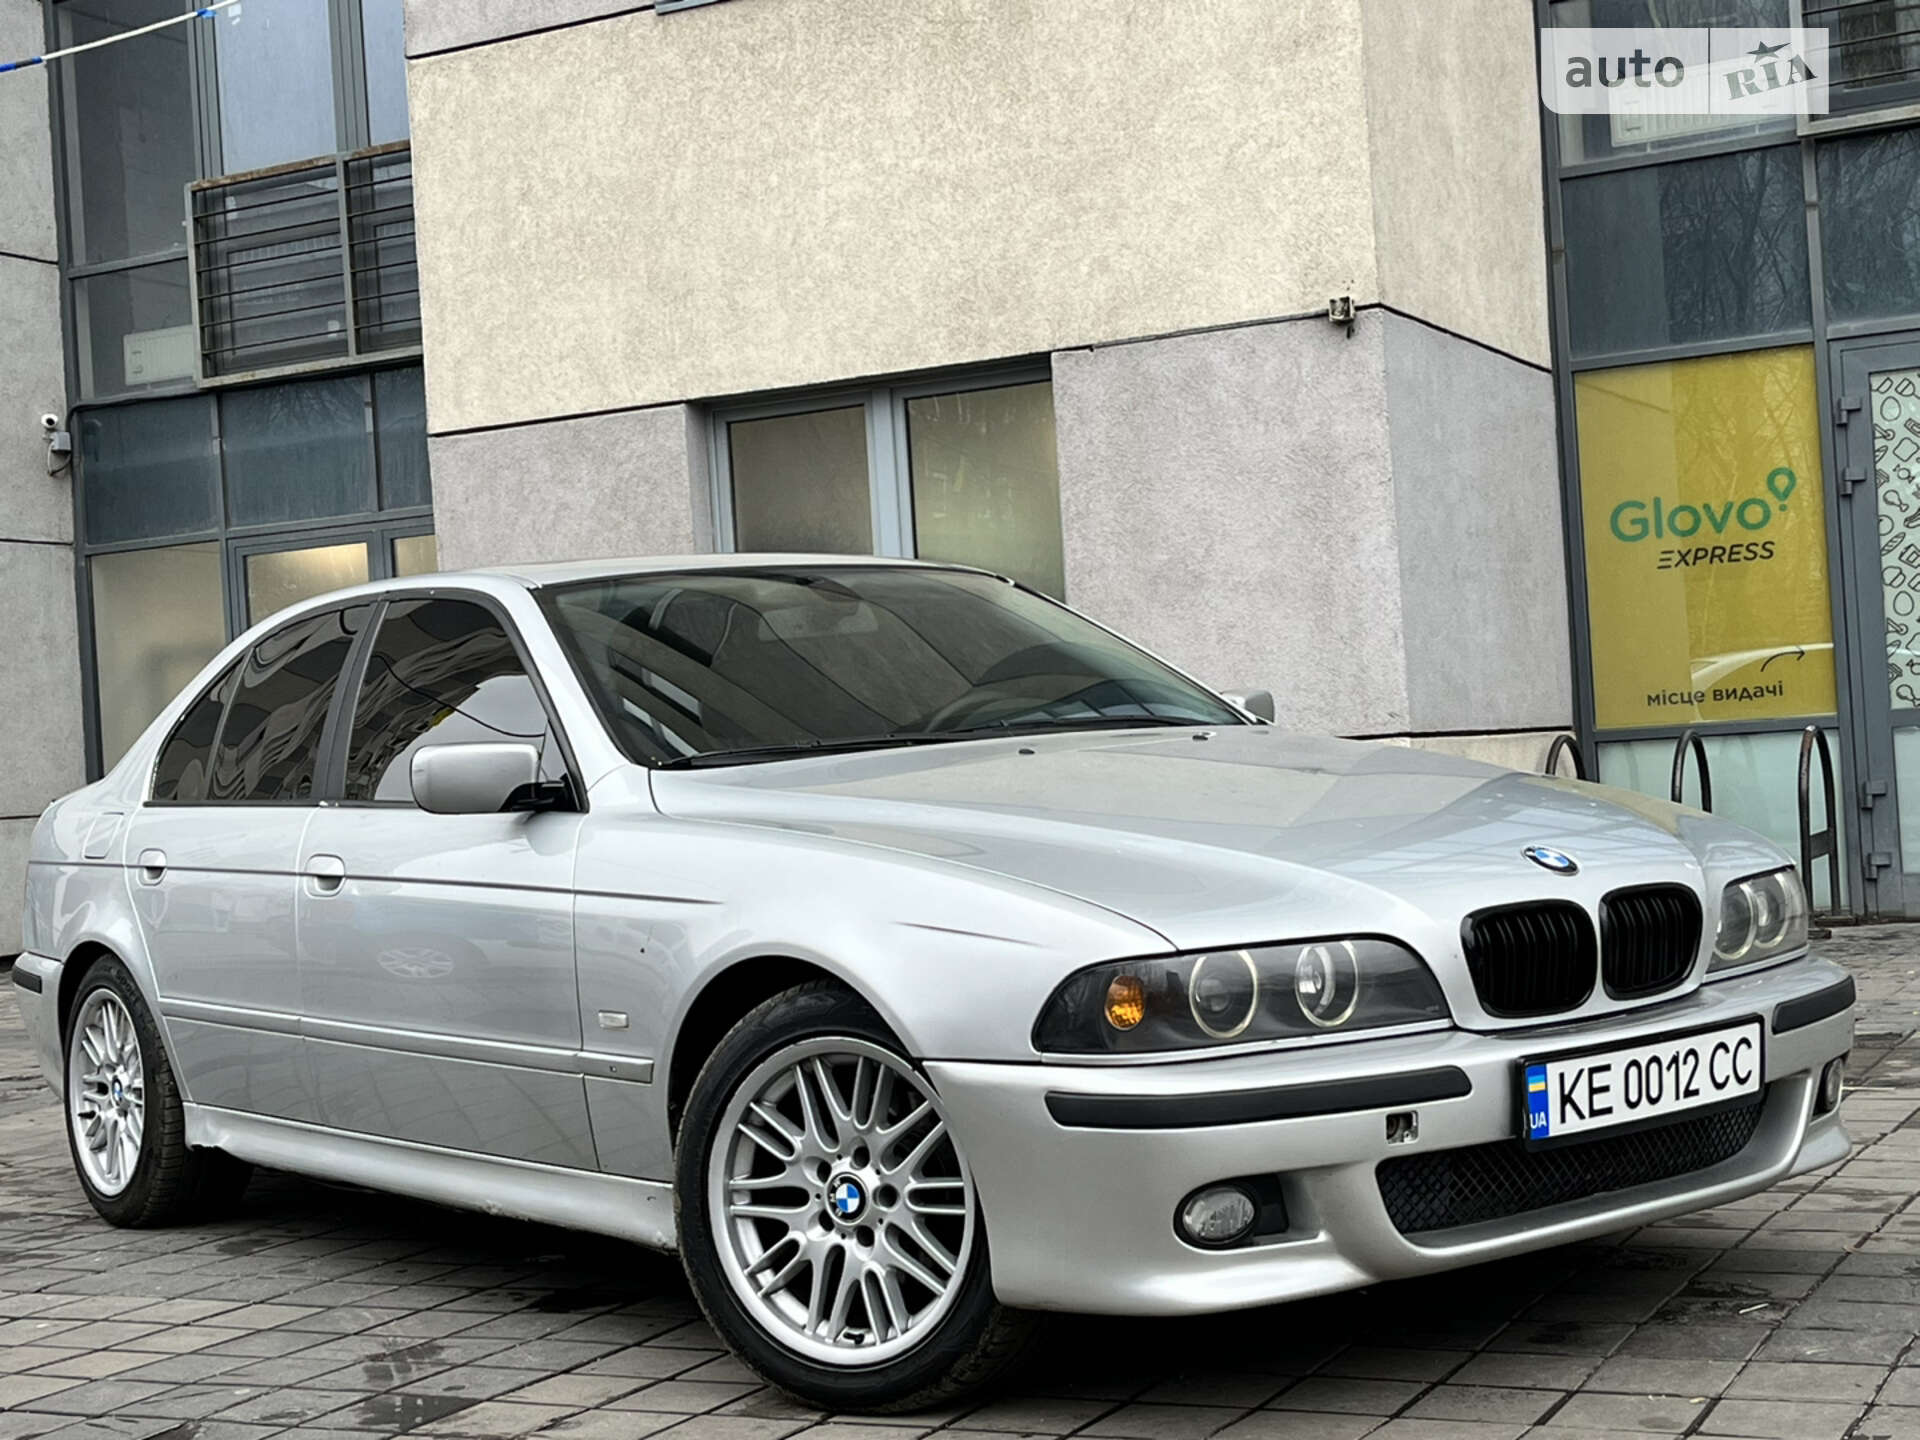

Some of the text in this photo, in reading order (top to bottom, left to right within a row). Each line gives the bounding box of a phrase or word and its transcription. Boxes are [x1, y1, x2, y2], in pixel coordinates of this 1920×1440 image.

[1610, 496, 1771, 543] Glovo
[1656, 541, 1775, 570] EXPRESS
[1712, 680, 1784, 702] видачі
[1559, 1036, 1753, 1124] KE 0012 CC
[1530, 1111, 1547, 1129] UA
